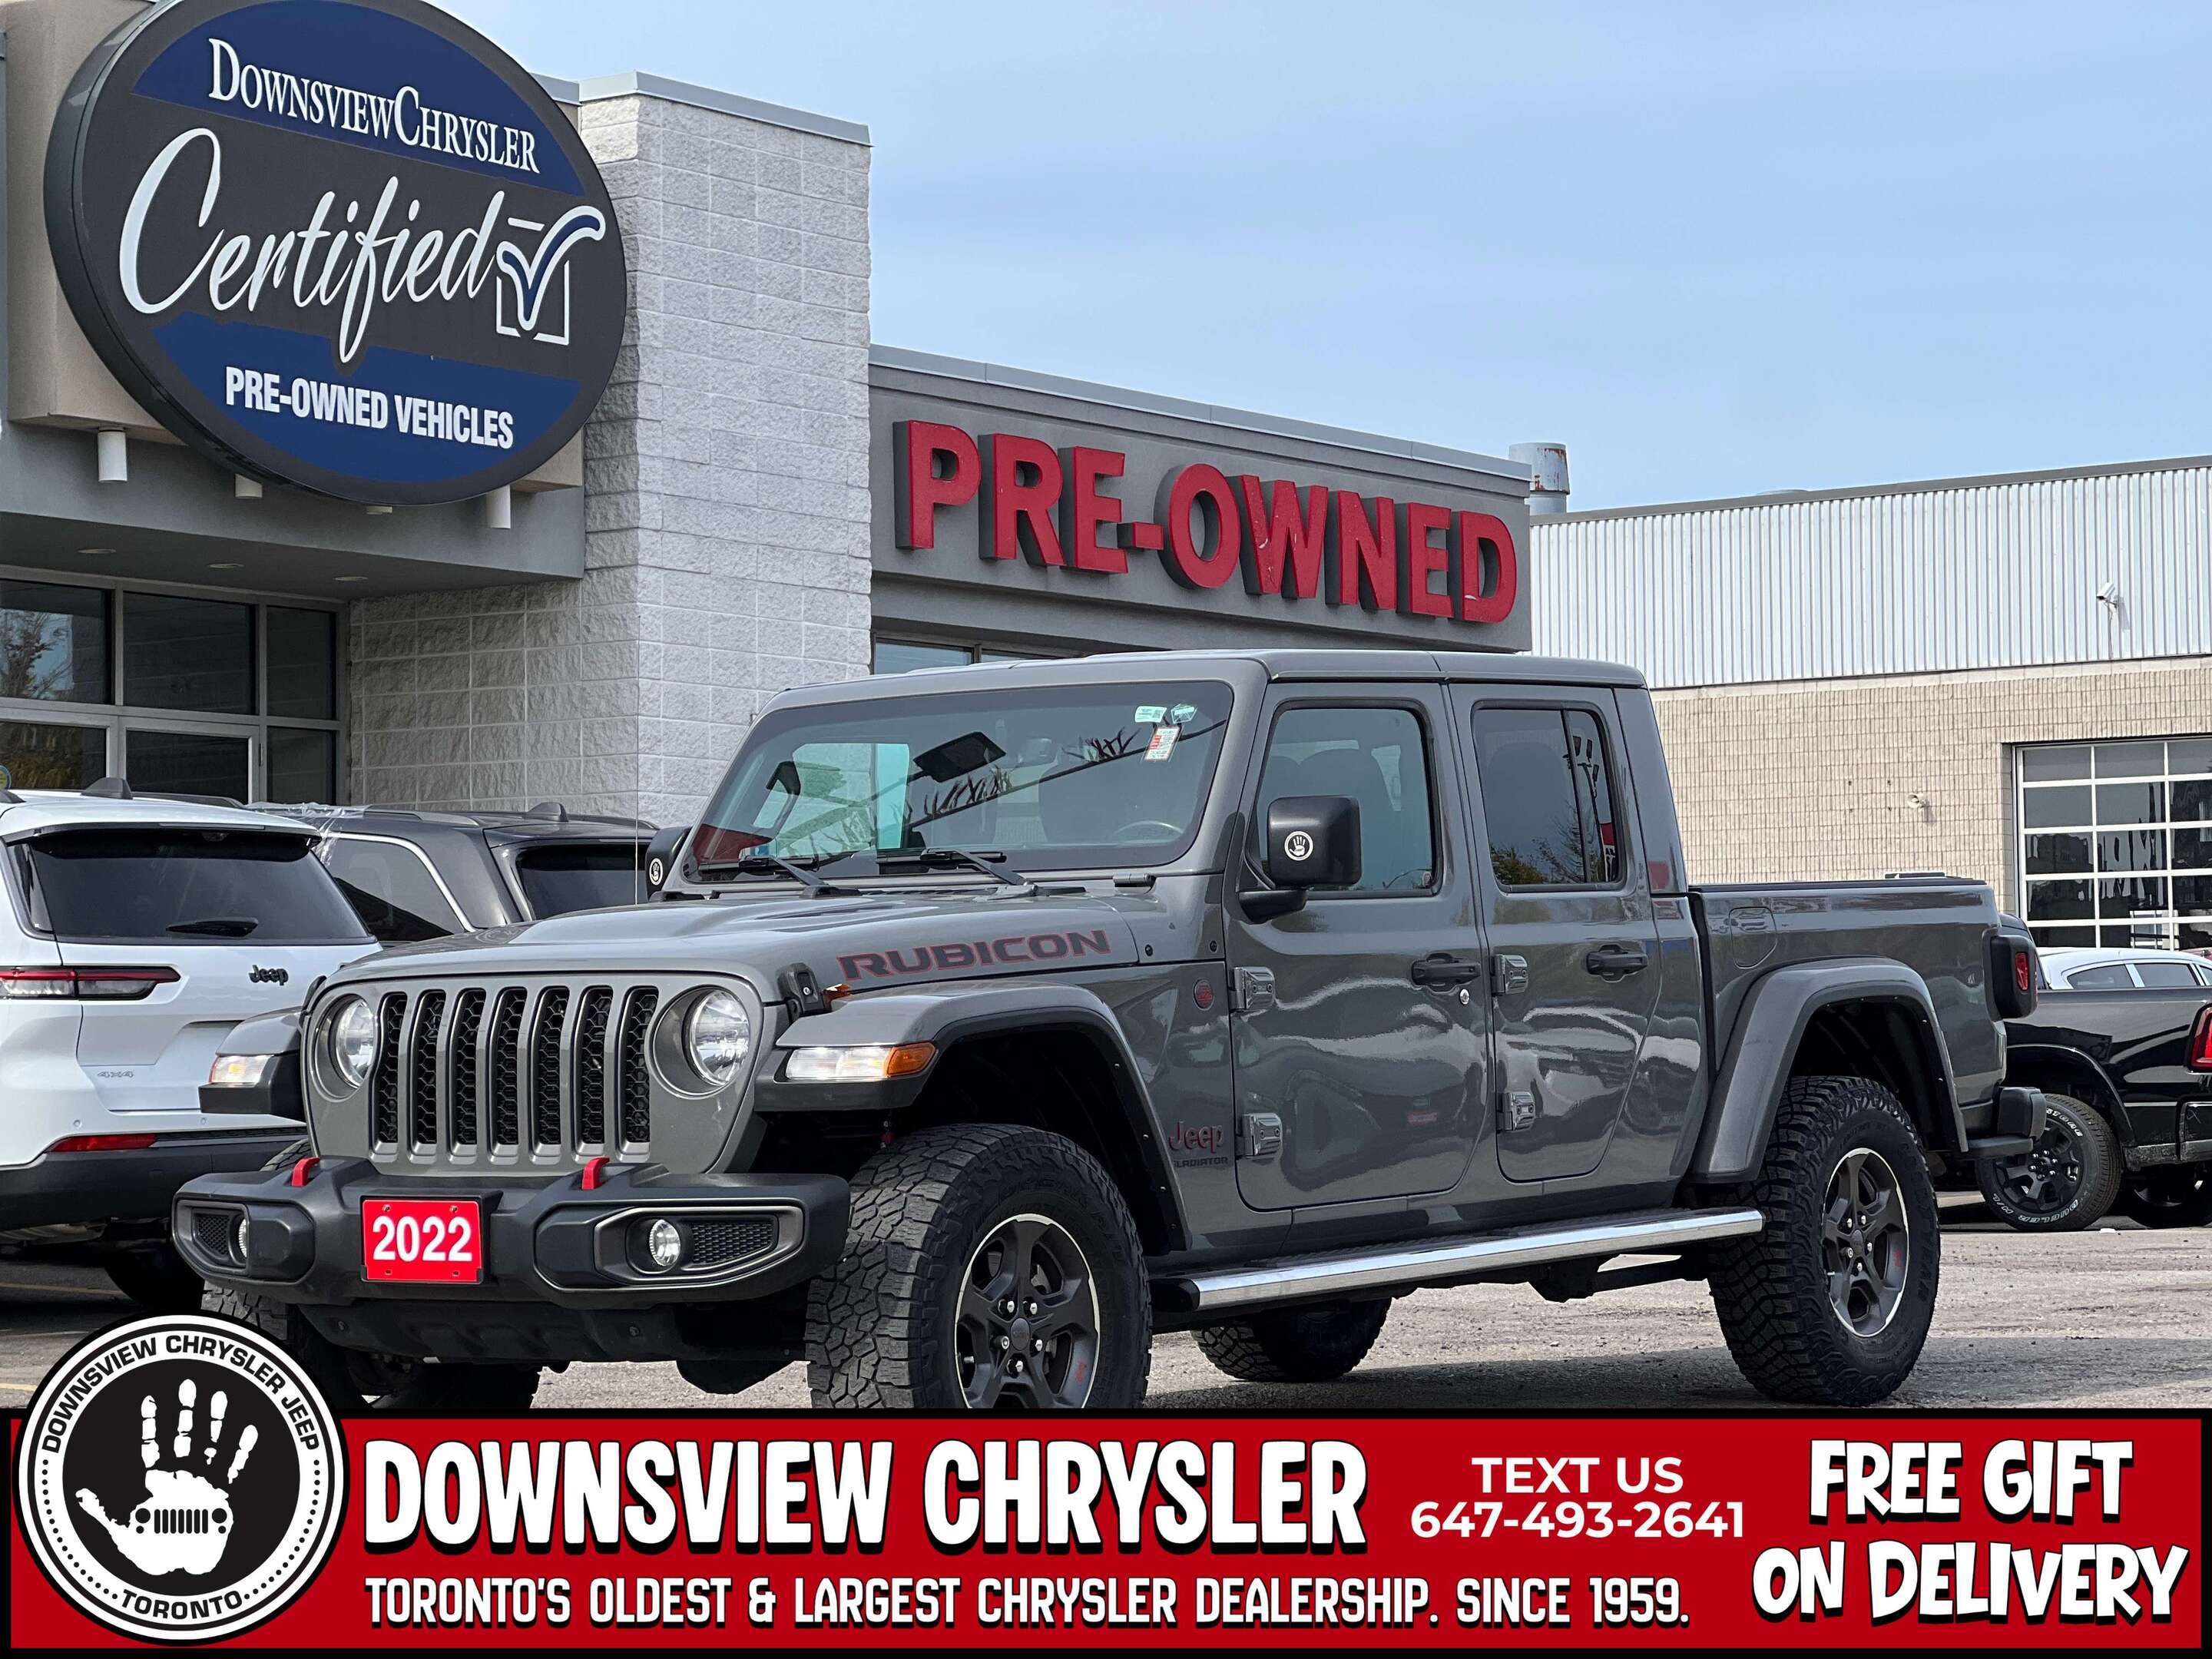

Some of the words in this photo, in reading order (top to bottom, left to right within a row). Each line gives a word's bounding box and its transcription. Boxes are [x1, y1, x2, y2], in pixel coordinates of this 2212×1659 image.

[119, 127, 505, 363] Certified
[225, 366, 389, 430] PRE-OWNED
[395, 393, 515, 450] VEHICLES
[896, 419, 1518, 623] PRE-OWNED
[248, 964, 289, 986] Jeep
[836, 929, 1112, 981] RUBICON
[1168, 1121, 1224, 1154] Jeep
[373, 1216, 473, 1262] 2022
